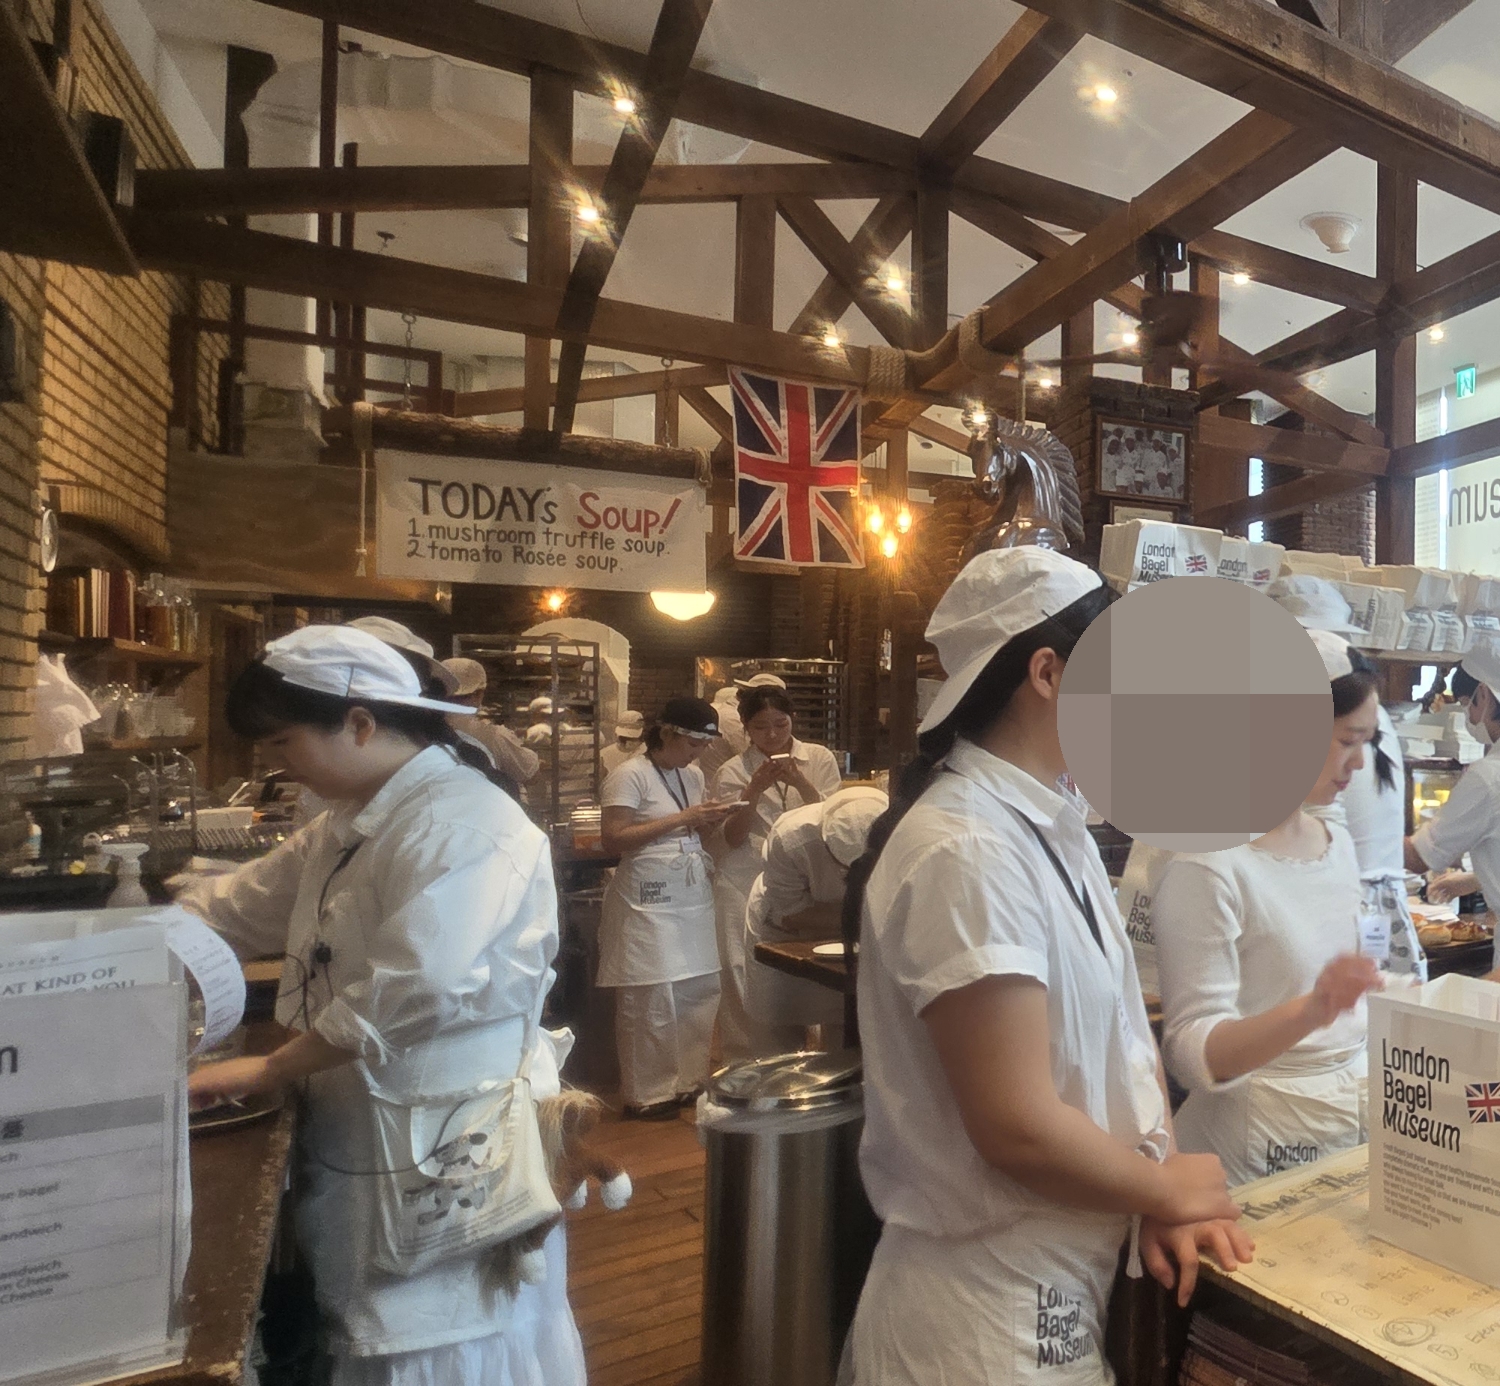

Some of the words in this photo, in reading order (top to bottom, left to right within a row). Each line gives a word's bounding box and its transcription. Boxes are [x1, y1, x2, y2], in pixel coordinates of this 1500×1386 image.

[576, 491, 682, 539] Soup!
[428, 523, 536, 545] mushroom
[543, 526, 616, 551] truffle
[623, 537, 671, 557] soup.
[427, 541, 502, 565] tomato
[575, 553, 624, 573] soup.
[1141, 555, 1169, 573] Bagel
[1217, 557, 1248, 573] ondon
[1125, 924, 1157, 946] Muse
[1129, 907, 1151, 931] Bag
[35, 971, 87, 992] KIND
[91, 966, 117, 980] OF
[1382, 1038, 1450, 1084] London
[1383, 1069, 1432, 1114] Bagel
[1382, 1101, 1461, 1153] Museum
[1266, 1140, 1318, 1163] London
[0, 1221, 63, 1242] andwich
[1036, 1306, 1080, 1342] Bagel
[1037, 1333, 1094, 1369] Museum
